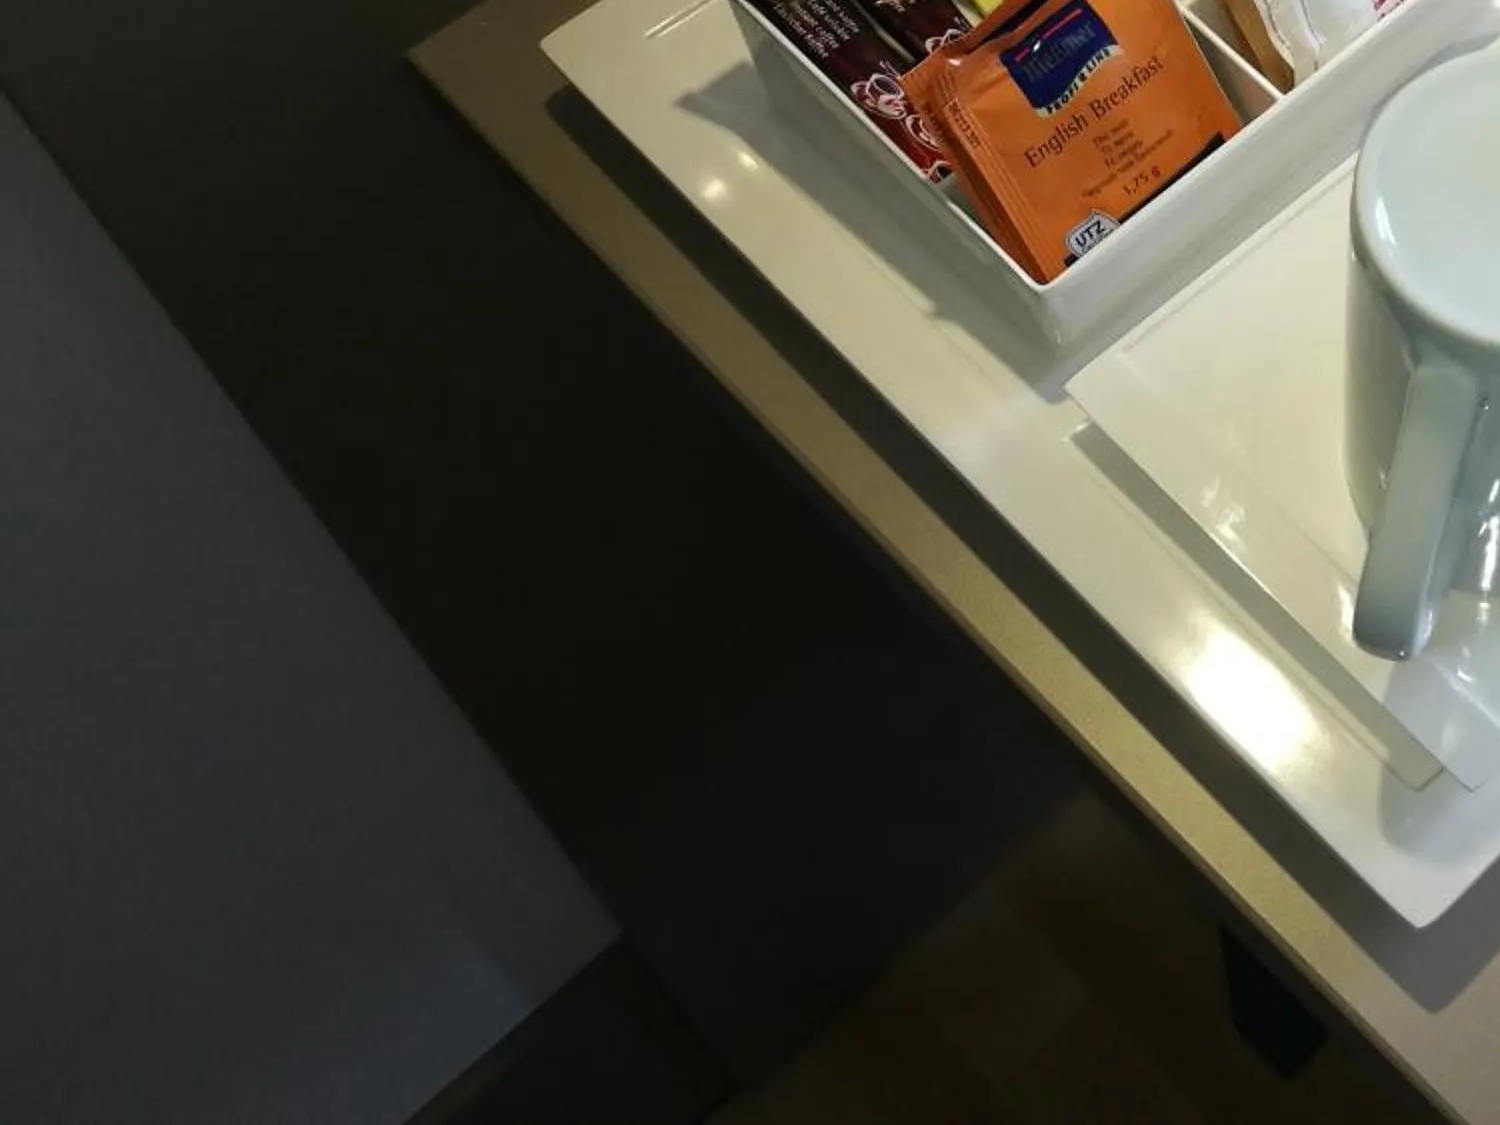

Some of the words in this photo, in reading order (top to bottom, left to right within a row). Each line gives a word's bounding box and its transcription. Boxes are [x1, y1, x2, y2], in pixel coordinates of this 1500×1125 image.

[1024, 114, 1089, 168] English
[1089, 55, 1164, 121] Breakfast
[1074, 219, 1106, 248] UTZ
